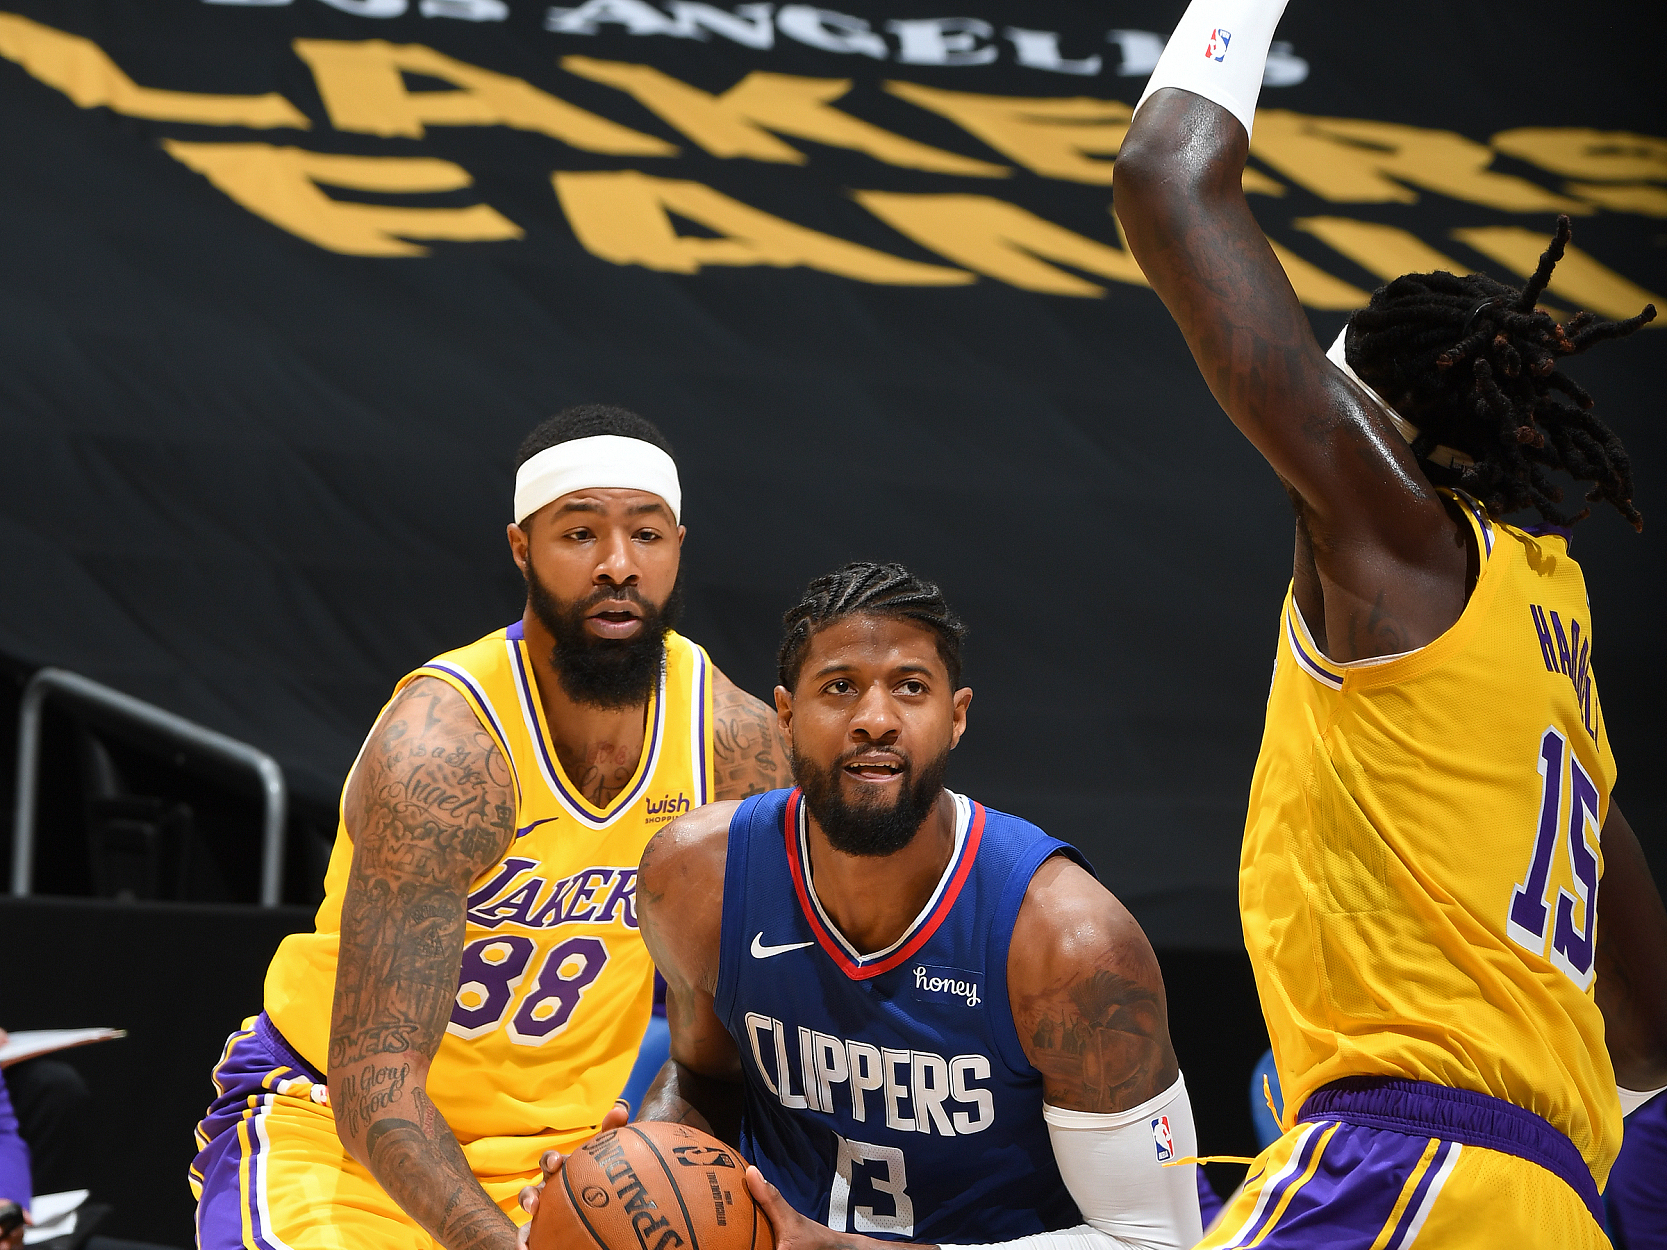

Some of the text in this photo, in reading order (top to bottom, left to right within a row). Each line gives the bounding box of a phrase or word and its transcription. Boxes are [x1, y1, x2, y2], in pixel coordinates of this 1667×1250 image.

[645, 792, 690, 815] wish
[1506, 724, 1600, 993] 15
[446, 935, 611, 1046] 88
[913, 967, 981, 1007] honey
[744, 1011, 994, 1137] CLIPPERS
[828, 1130, 914, 1237] 13
